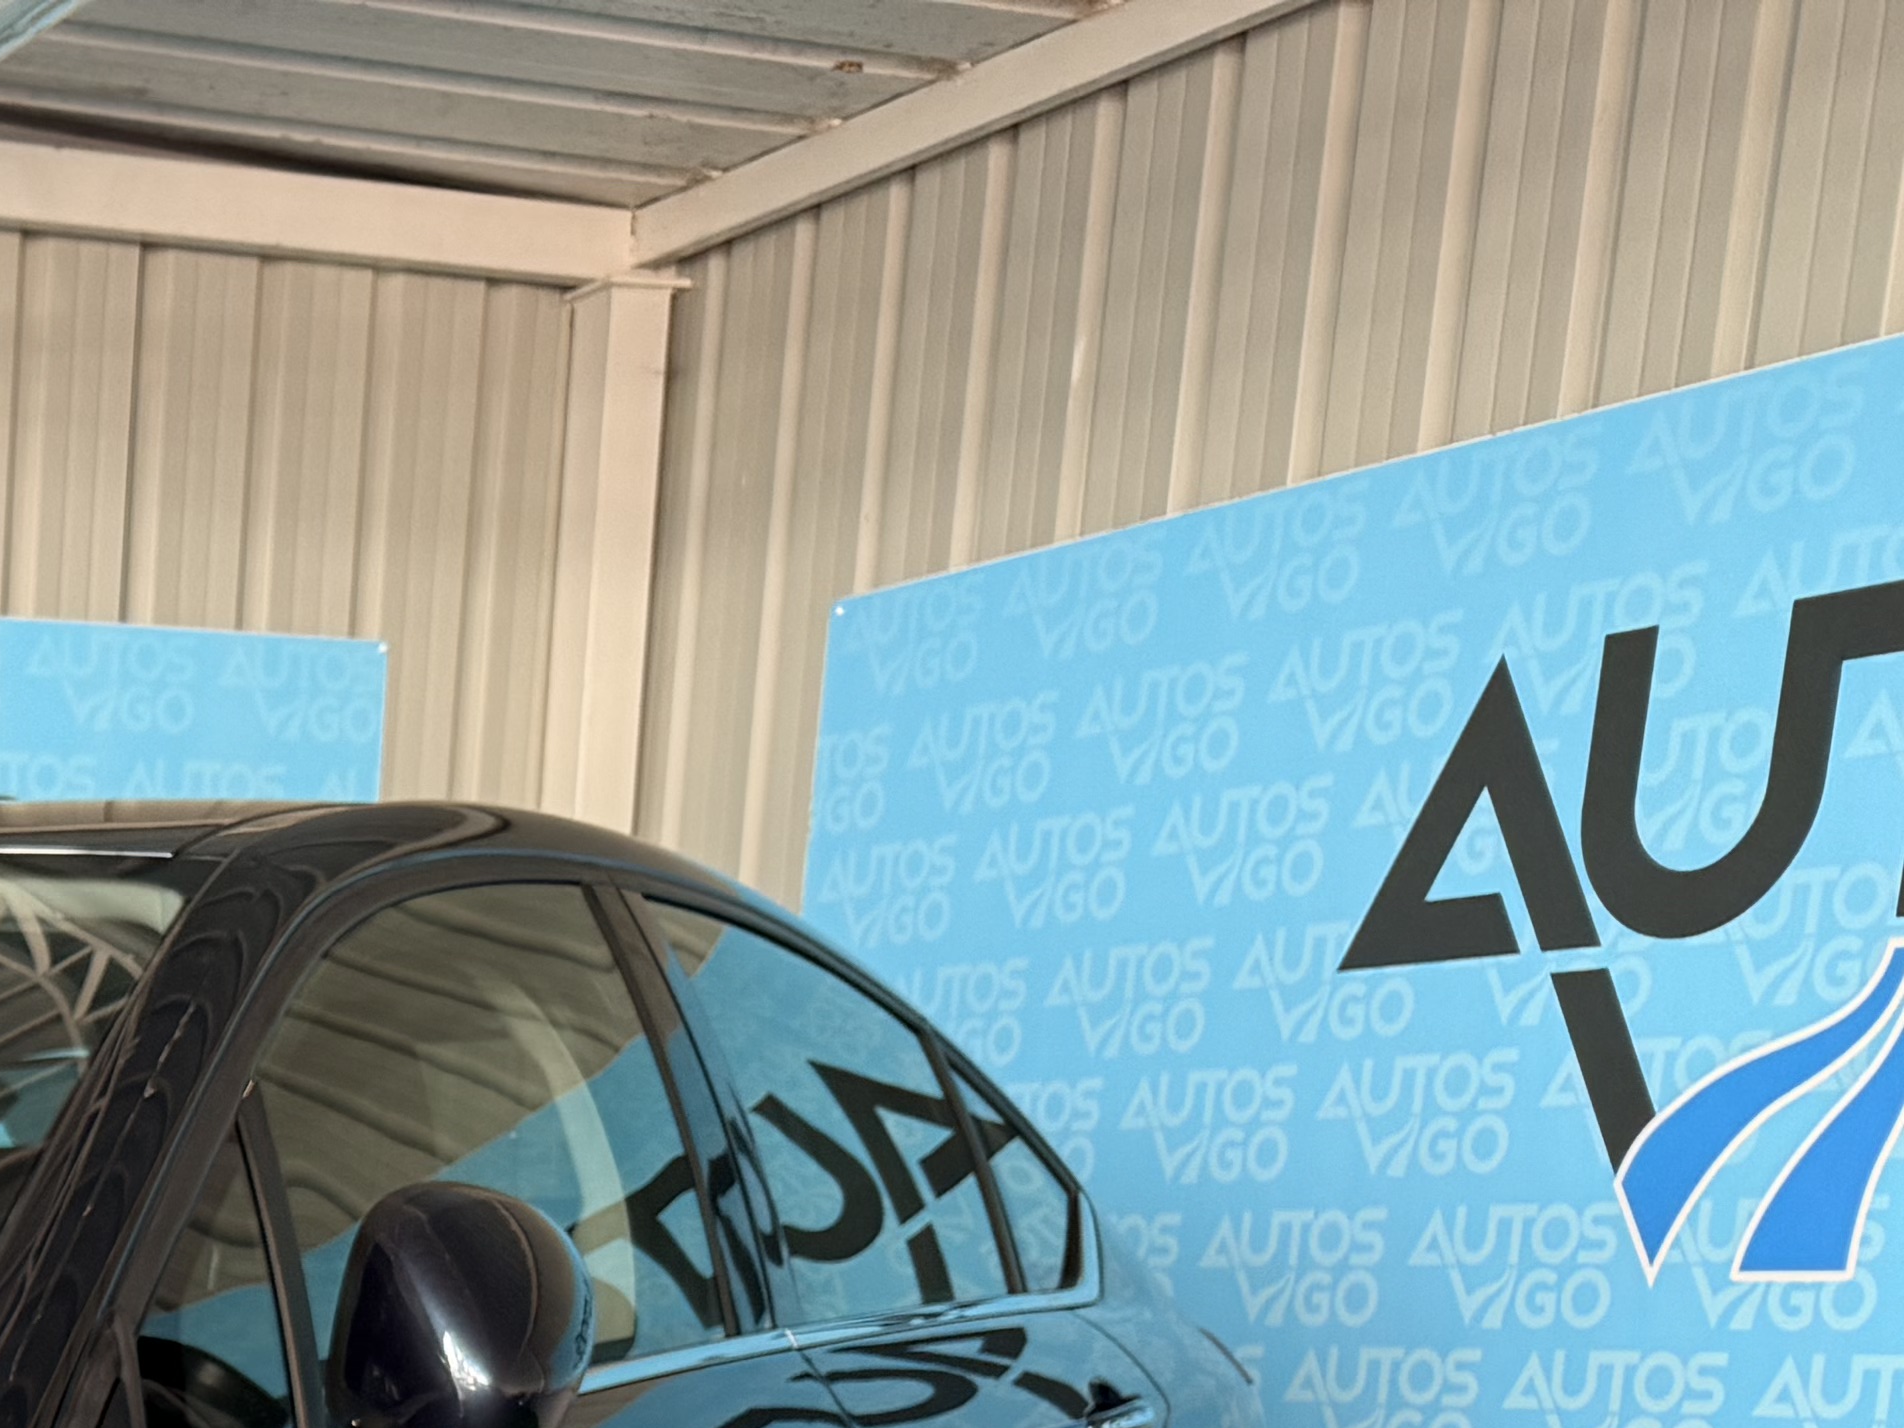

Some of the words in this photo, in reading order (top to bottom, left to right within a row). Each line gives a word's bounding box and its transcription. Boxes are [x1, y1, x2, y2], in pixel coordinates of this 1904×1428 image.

[1487, 559, 1705, 660] AUTOS
[1269, 611, 1461, 703] AUTOS
[906, 691, 1058, 770] AUTOS
[1076, 654, 1246, 739] AUTOS
[974, 806, 1133, 881] AUTOS
[1152, 776, 1331, 856] AUTOS
[814, 833, 956, 903] AUTOS
[1045, 937, 1212, 1008] AUTOS
[1121, 1064, 1296, 1130] AUTOS
[1319, 1049, 1517, 1120] AUTOS
[1201, 1207, 1386, 1269] AUTOS
[1410, 1202, 1618, 1268] AUTOS
[1286, 1345, 1481, 1404] AUTOS
[1505, 1349, 1727, 1412] AUTOS
